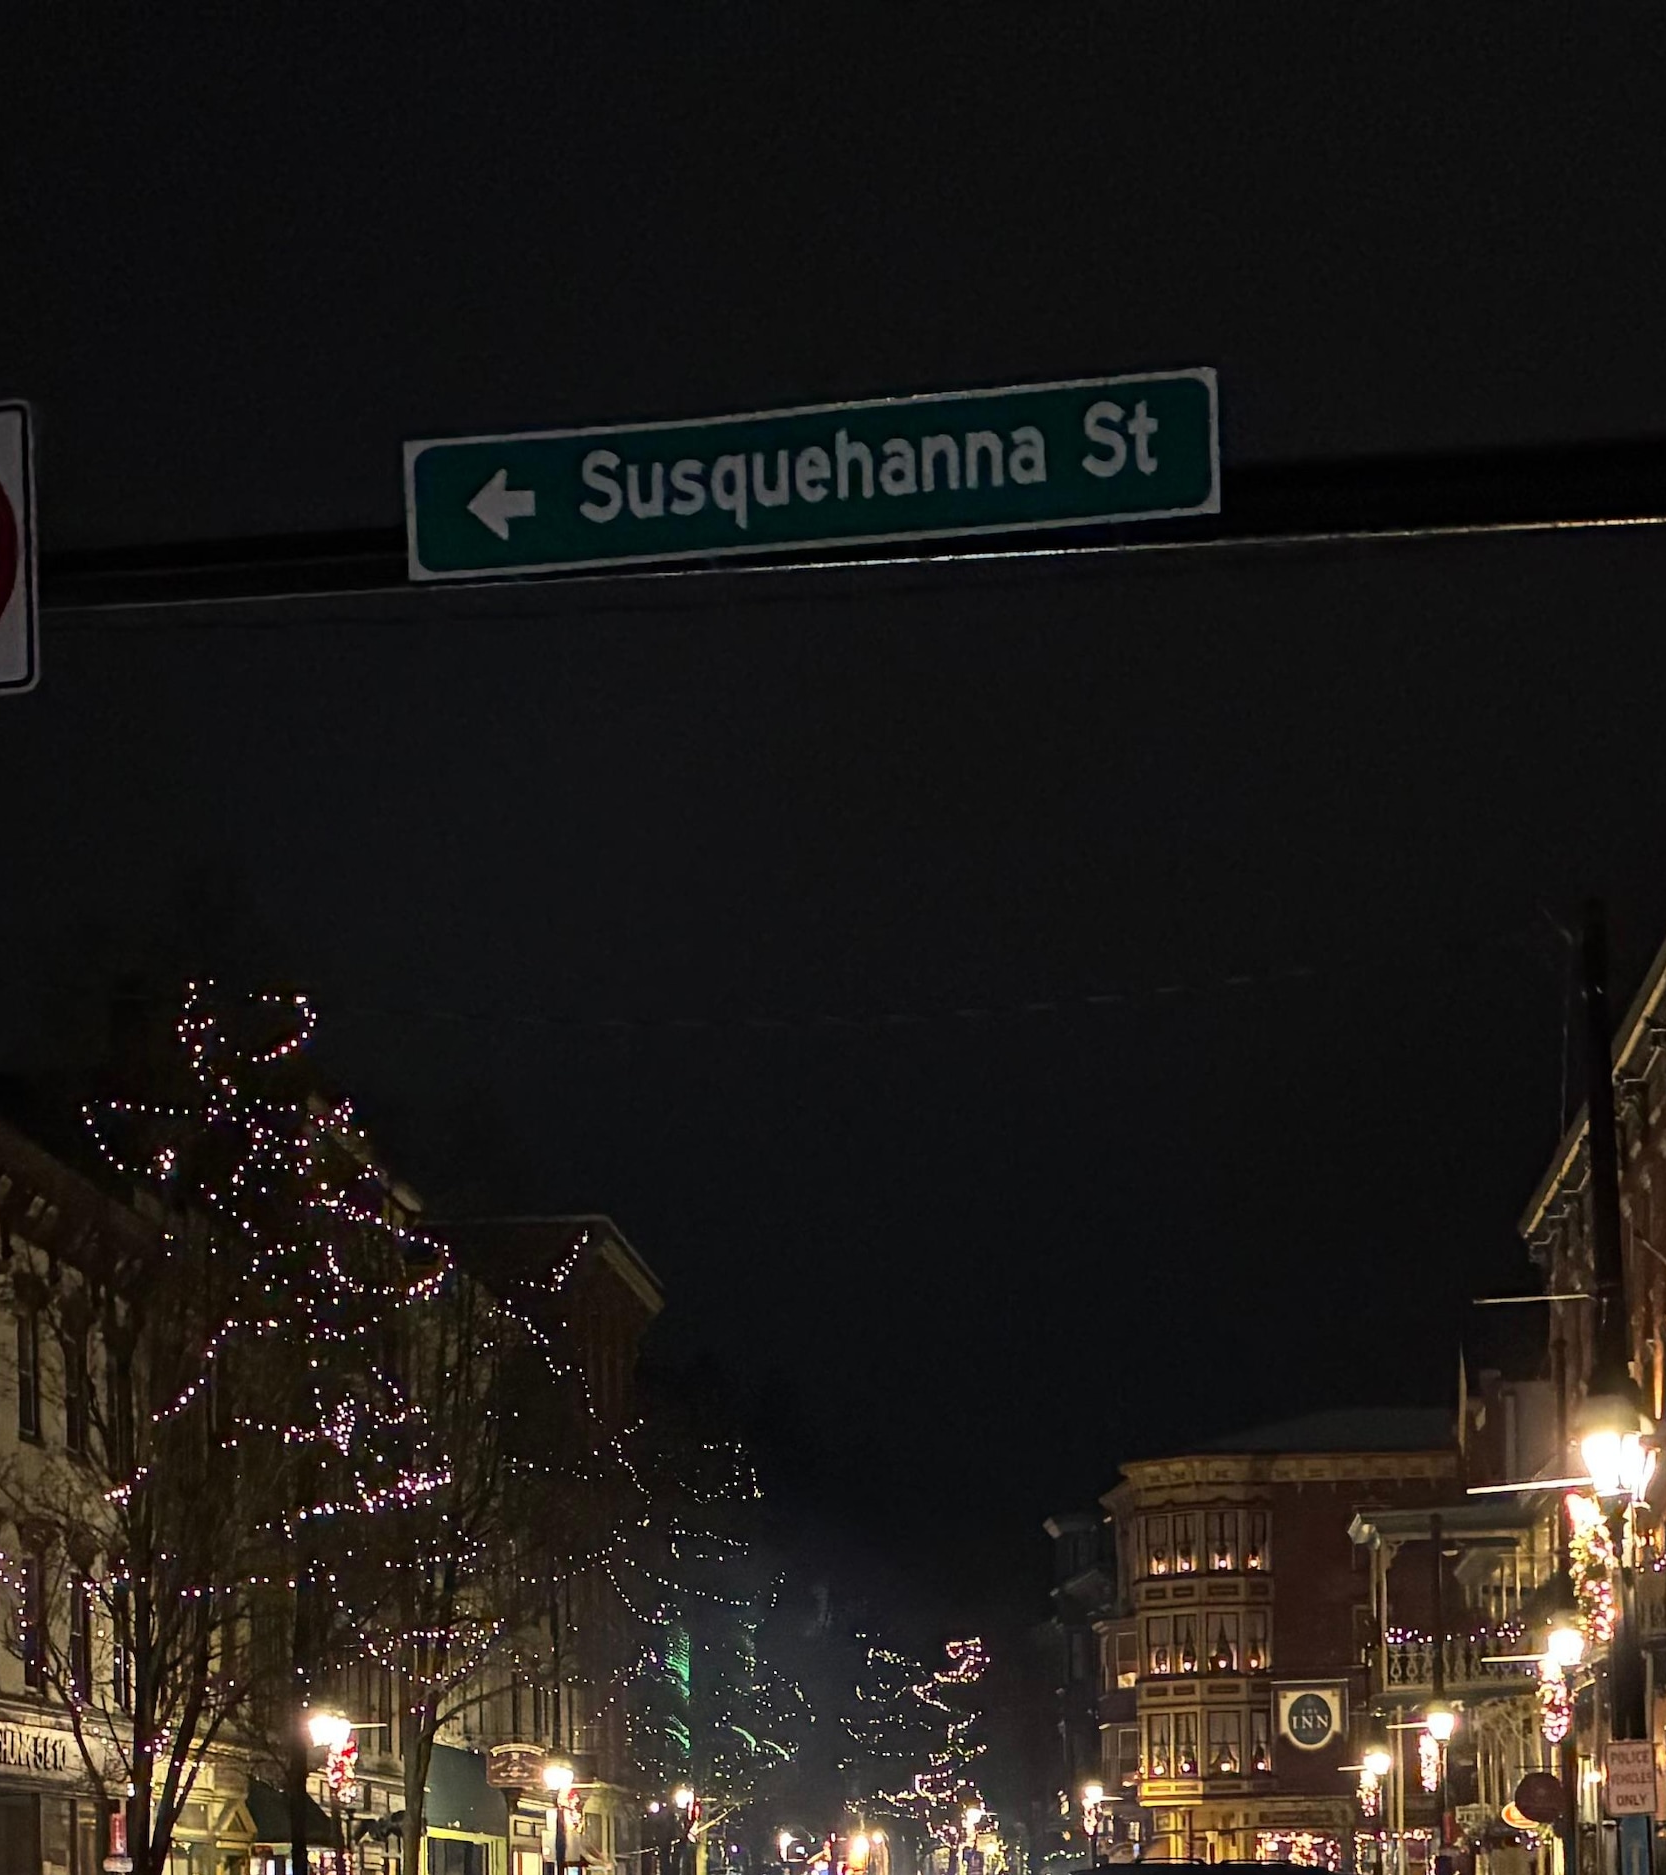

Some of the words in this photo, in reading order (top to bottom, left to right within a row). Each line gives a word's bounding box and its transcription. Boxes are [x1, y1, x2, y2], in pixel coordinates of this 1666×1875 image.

[579, 425, 1047, 530] Susquehanna
[1081, 400, 1159, 477] St
[1292, 1714, 1329, 1730] INN
[1610, 1750, 1650, 1764] POLICE
[1610, 1771, 1653, 1786] VEHICLES
[1616, 1793, 1647, 1806] ONLY
